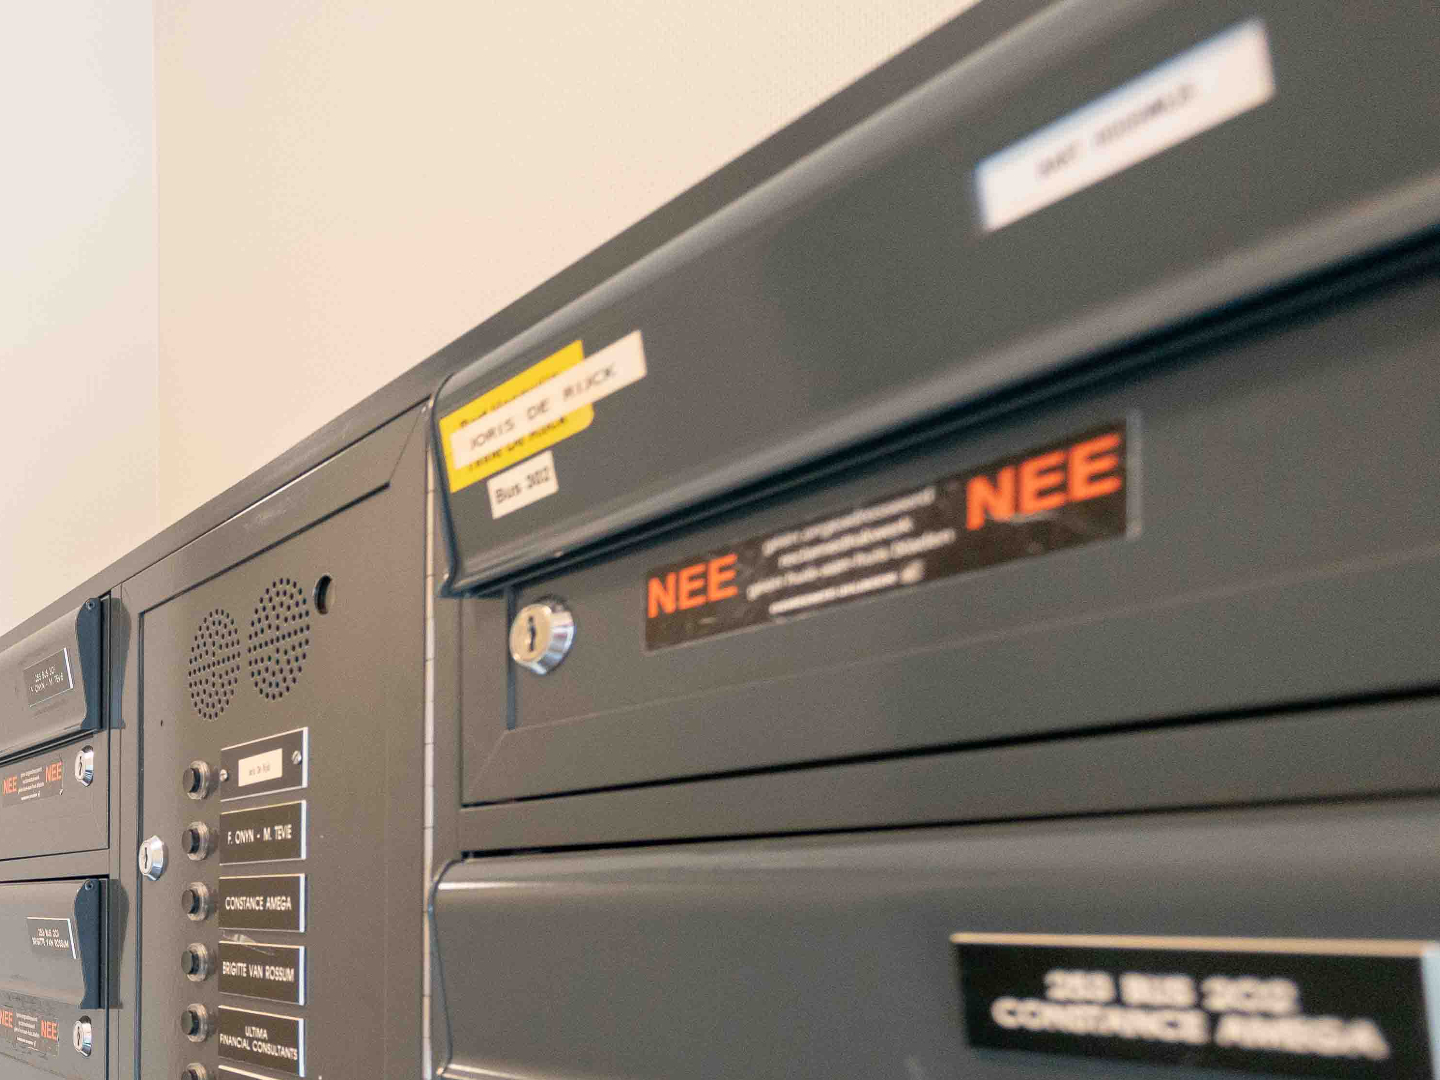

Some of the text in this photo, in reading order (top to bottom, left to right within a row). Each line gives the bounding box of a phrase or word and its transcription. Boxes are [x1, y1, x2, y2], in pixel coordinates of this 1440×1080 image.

[469, 416, 516, 451] JORIS
[525, 398, 550, 421] DE
[964, 432, 1123, 531] NEE
[494, 482, 523, 504] Bus
[646, 553, 740, 620] NEE
[45, 762, 62, 783] NEE
[3, 775, 18, 797] NEE
[224, 896, 292, 911] CONSTANCE AMEGA
[222, 961, 295, 983] BRIGITTE VAN ROSSUM
[0, 1009, 14, 1029] NEE
[991, 996, 1210, 1047] CONSTANCE
[41, 1019, 58, 1042] NEE
[244, 1025, 268, 1040] ULTIMA
[219, 1033, 298, 1061] FINANCIAL CONSULTANTS
